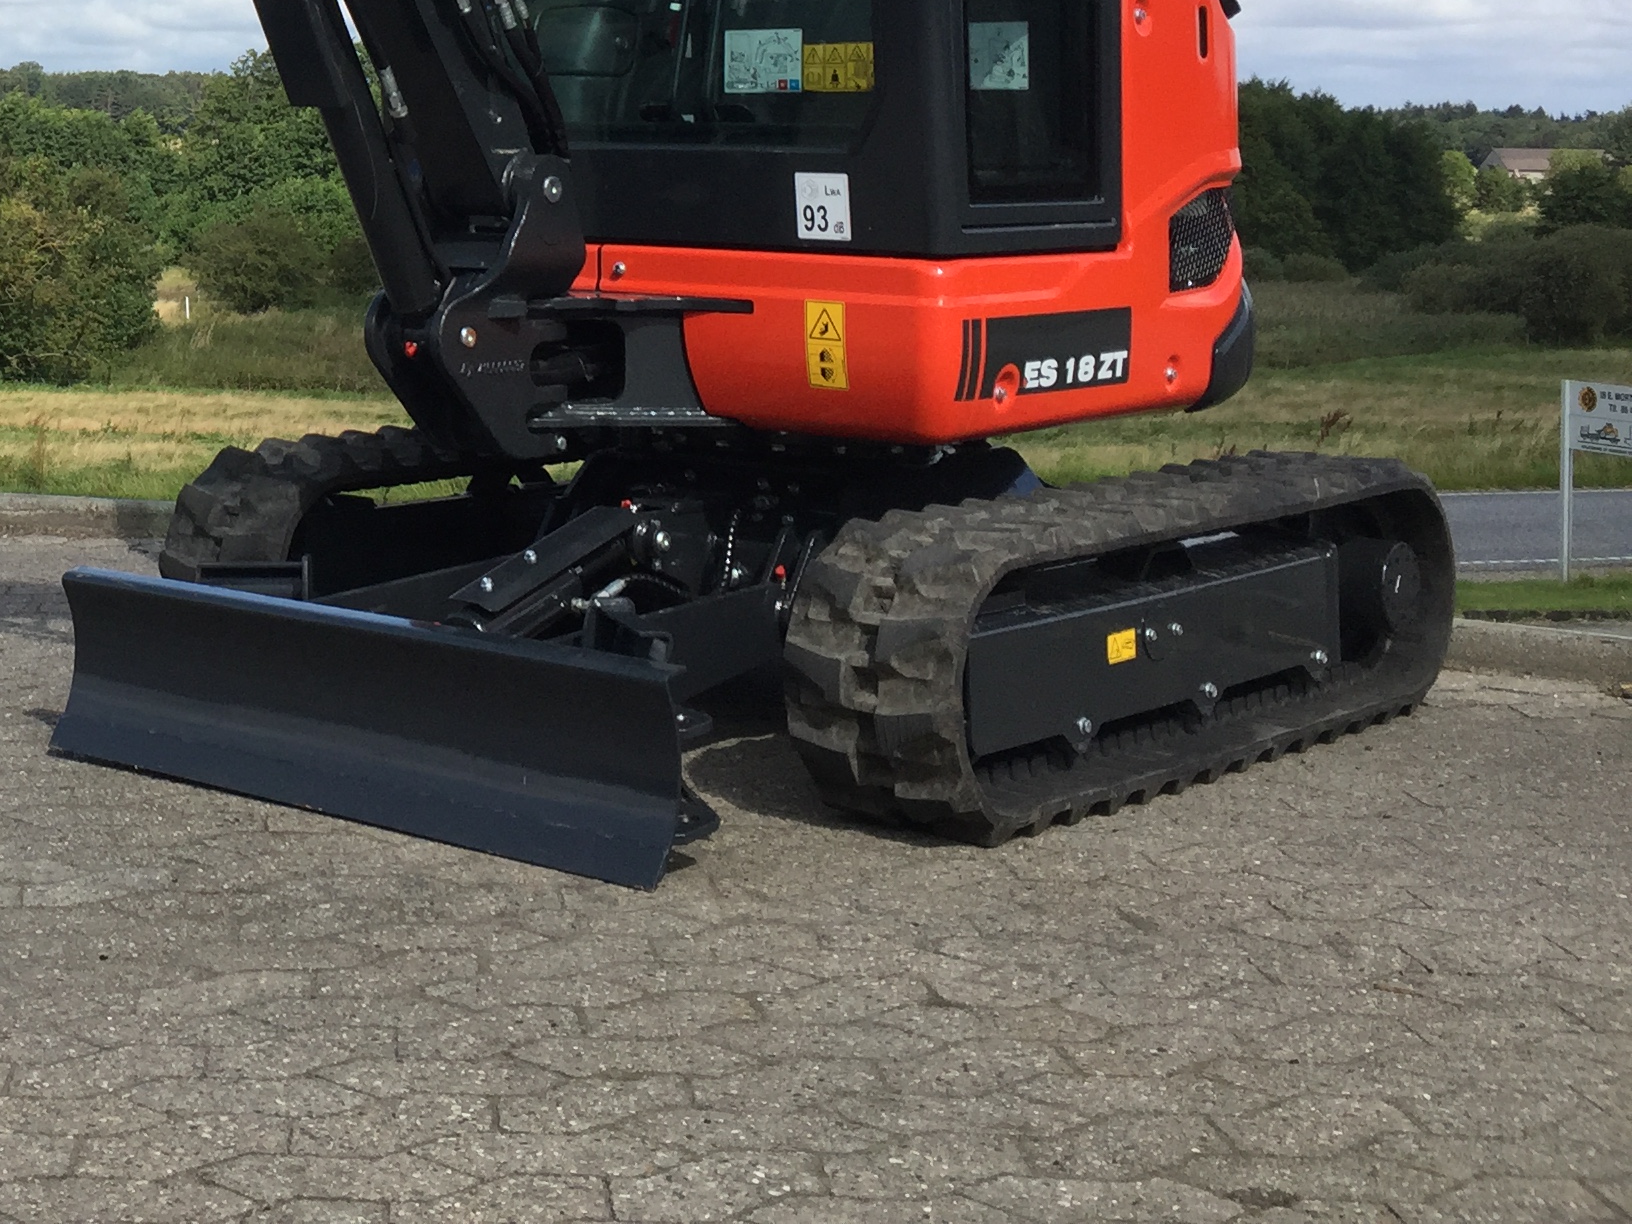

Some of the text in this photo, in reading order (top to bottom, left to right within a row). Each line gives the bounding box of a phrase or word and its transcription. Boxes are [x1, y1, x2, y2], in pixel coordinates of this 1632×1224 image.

[803, 204, 829, 233] 93
[1024, 350, 1128, 389] ES 18 ZT
